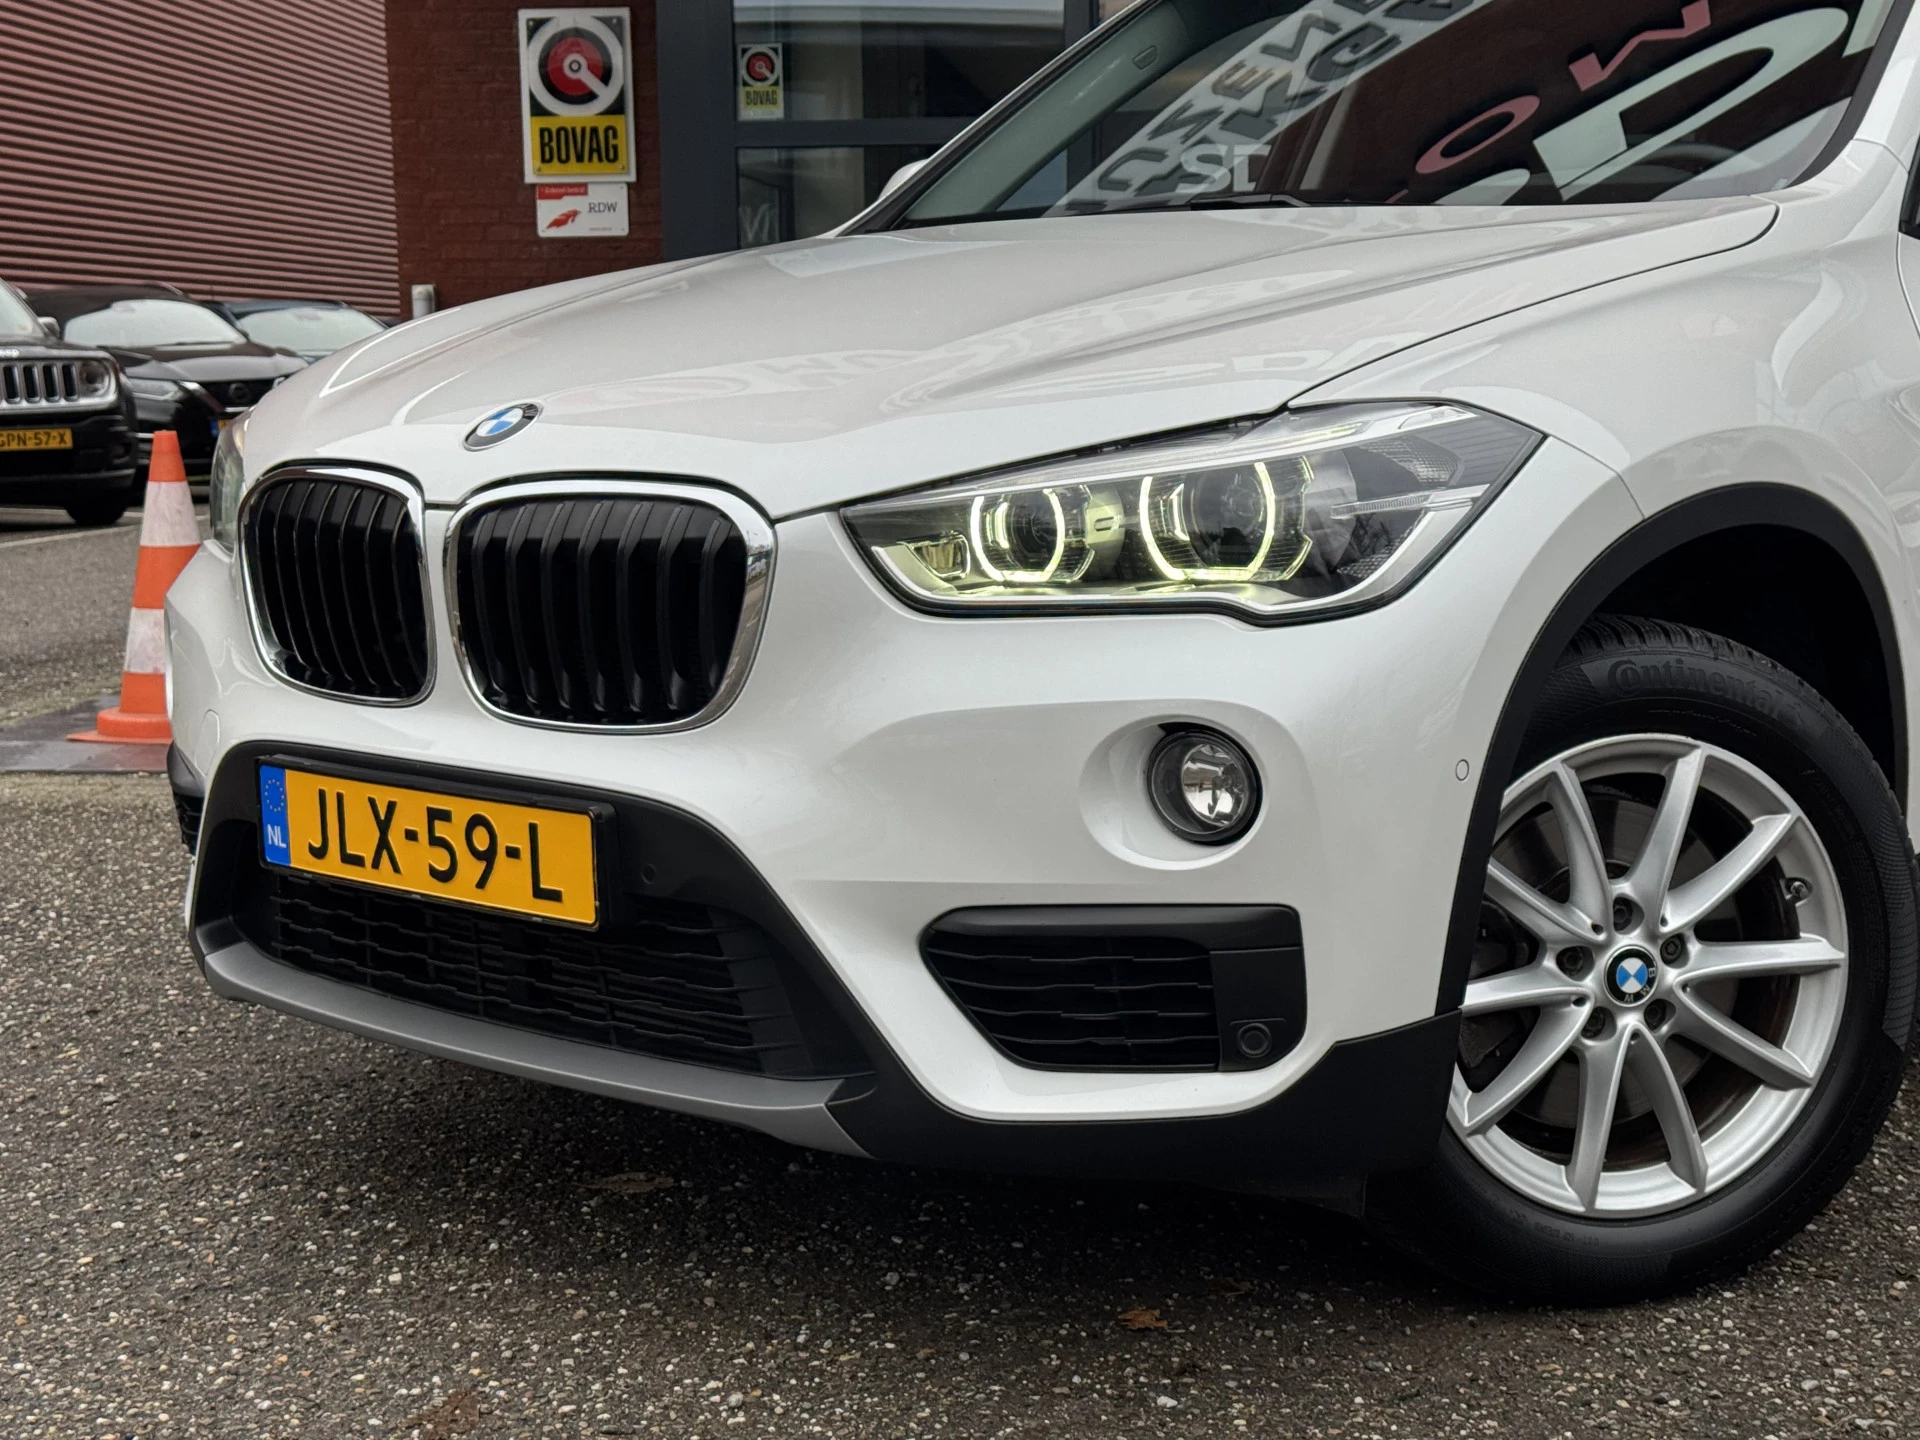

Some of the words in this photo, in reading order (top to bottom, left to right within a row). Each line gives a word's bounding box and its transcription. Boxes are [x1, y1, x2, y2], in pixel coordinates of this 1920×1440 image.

[745, 89, 778, 106] BOVAG
[539, 125, 619, 164] BOVAG
[588, 202, 617, 213] RDW
[1607, 657, 1783, 721] Continental
[267, 824, 287, 848] NL
[308, 788, 563, 902] JLX-59-L
